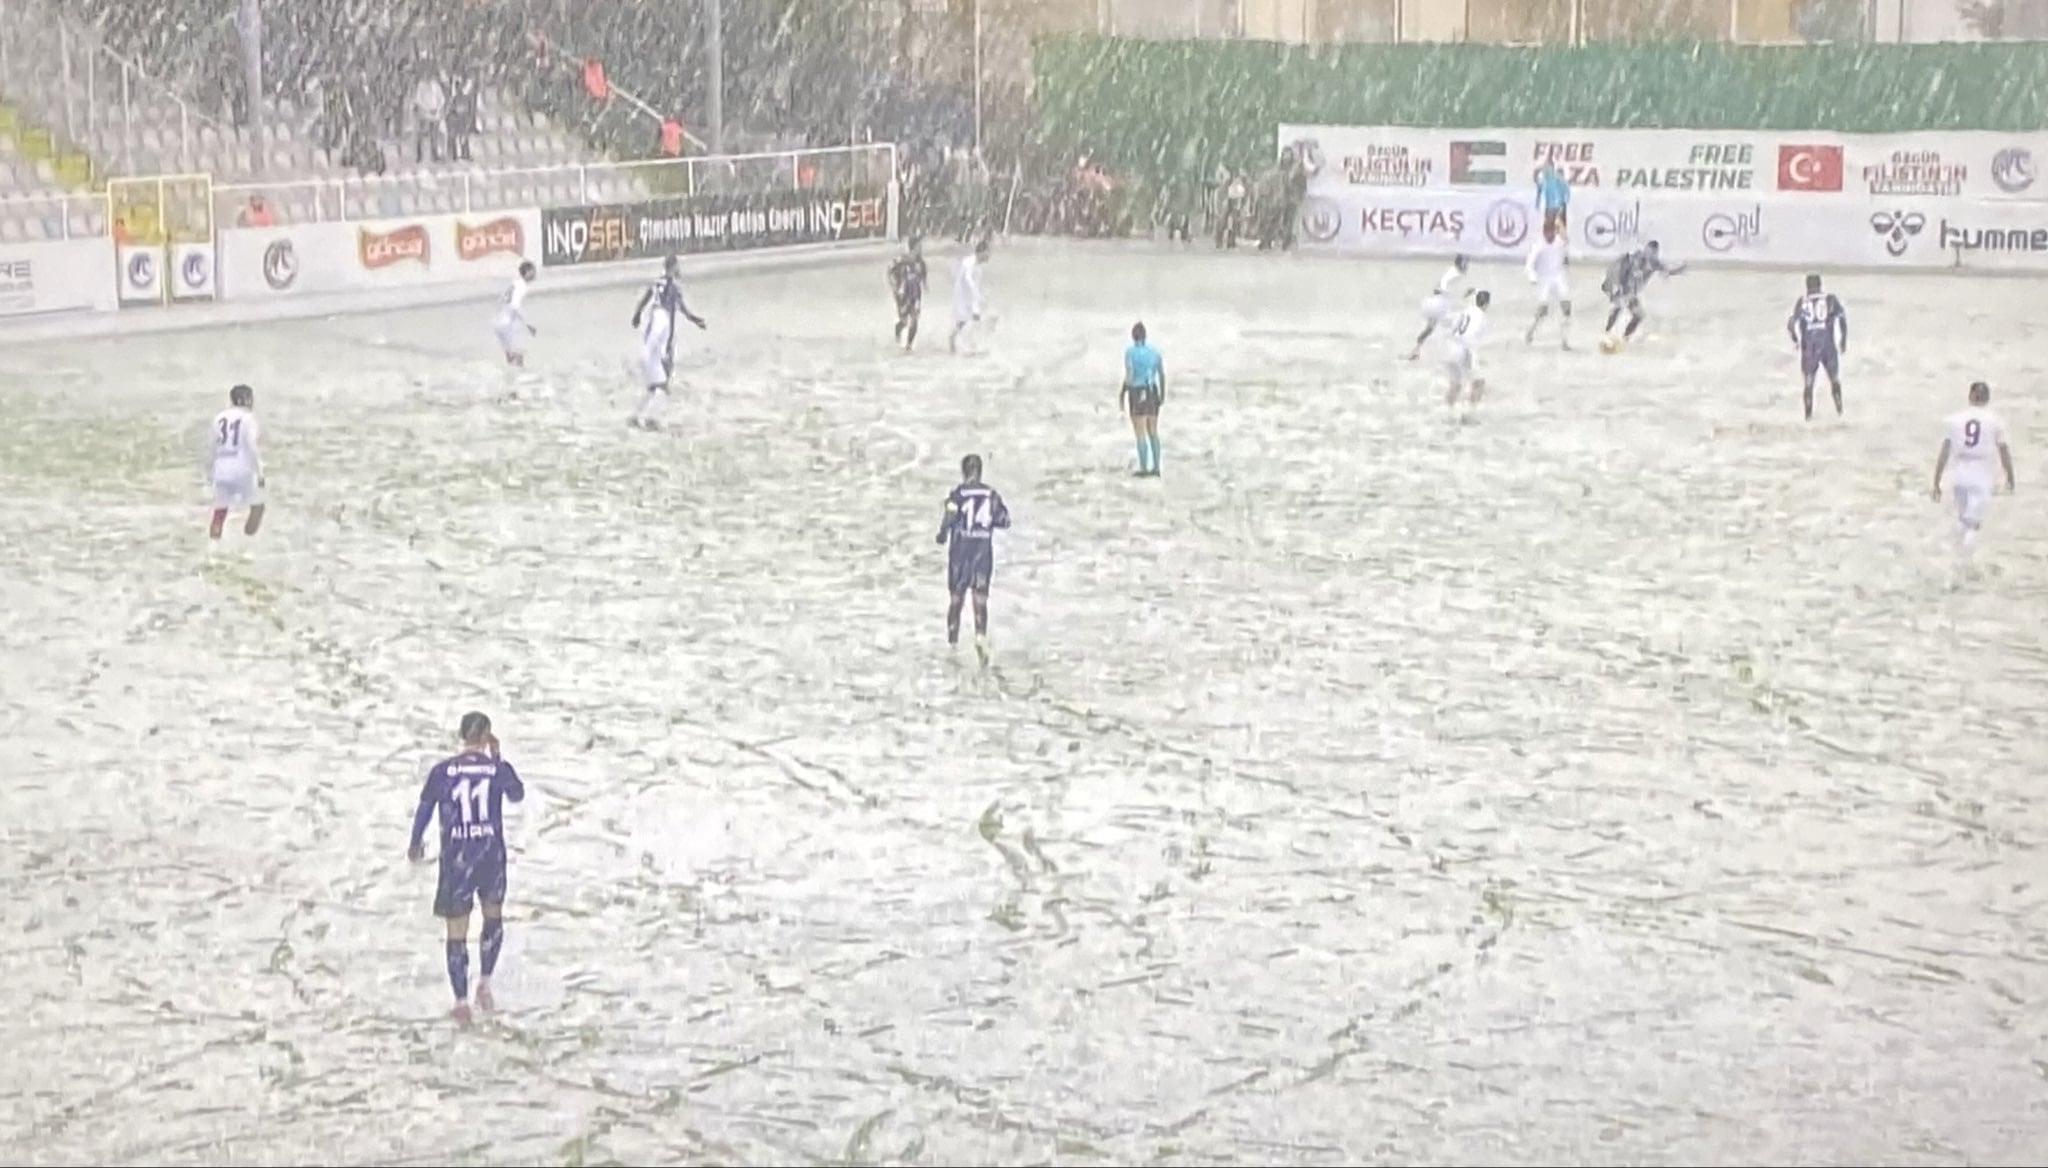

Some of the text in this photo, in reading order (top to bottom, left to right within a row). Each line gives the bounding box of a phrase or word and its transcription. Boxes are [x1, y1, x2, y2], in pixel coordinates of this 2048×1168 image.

[1533, 141, 1594, 162] FREE
[1690, 143, 1753, 163] FREE
[1615, 168, 1753, 189] PALESTINE
[1361, 208, 1464, 239] KEÇTAŞ
[217, 417, 241, 446] 31
[1964, 419, 1981, 448] 9
[961, 497, 993, 529] 14
[452, 778, 490, 823] 11
